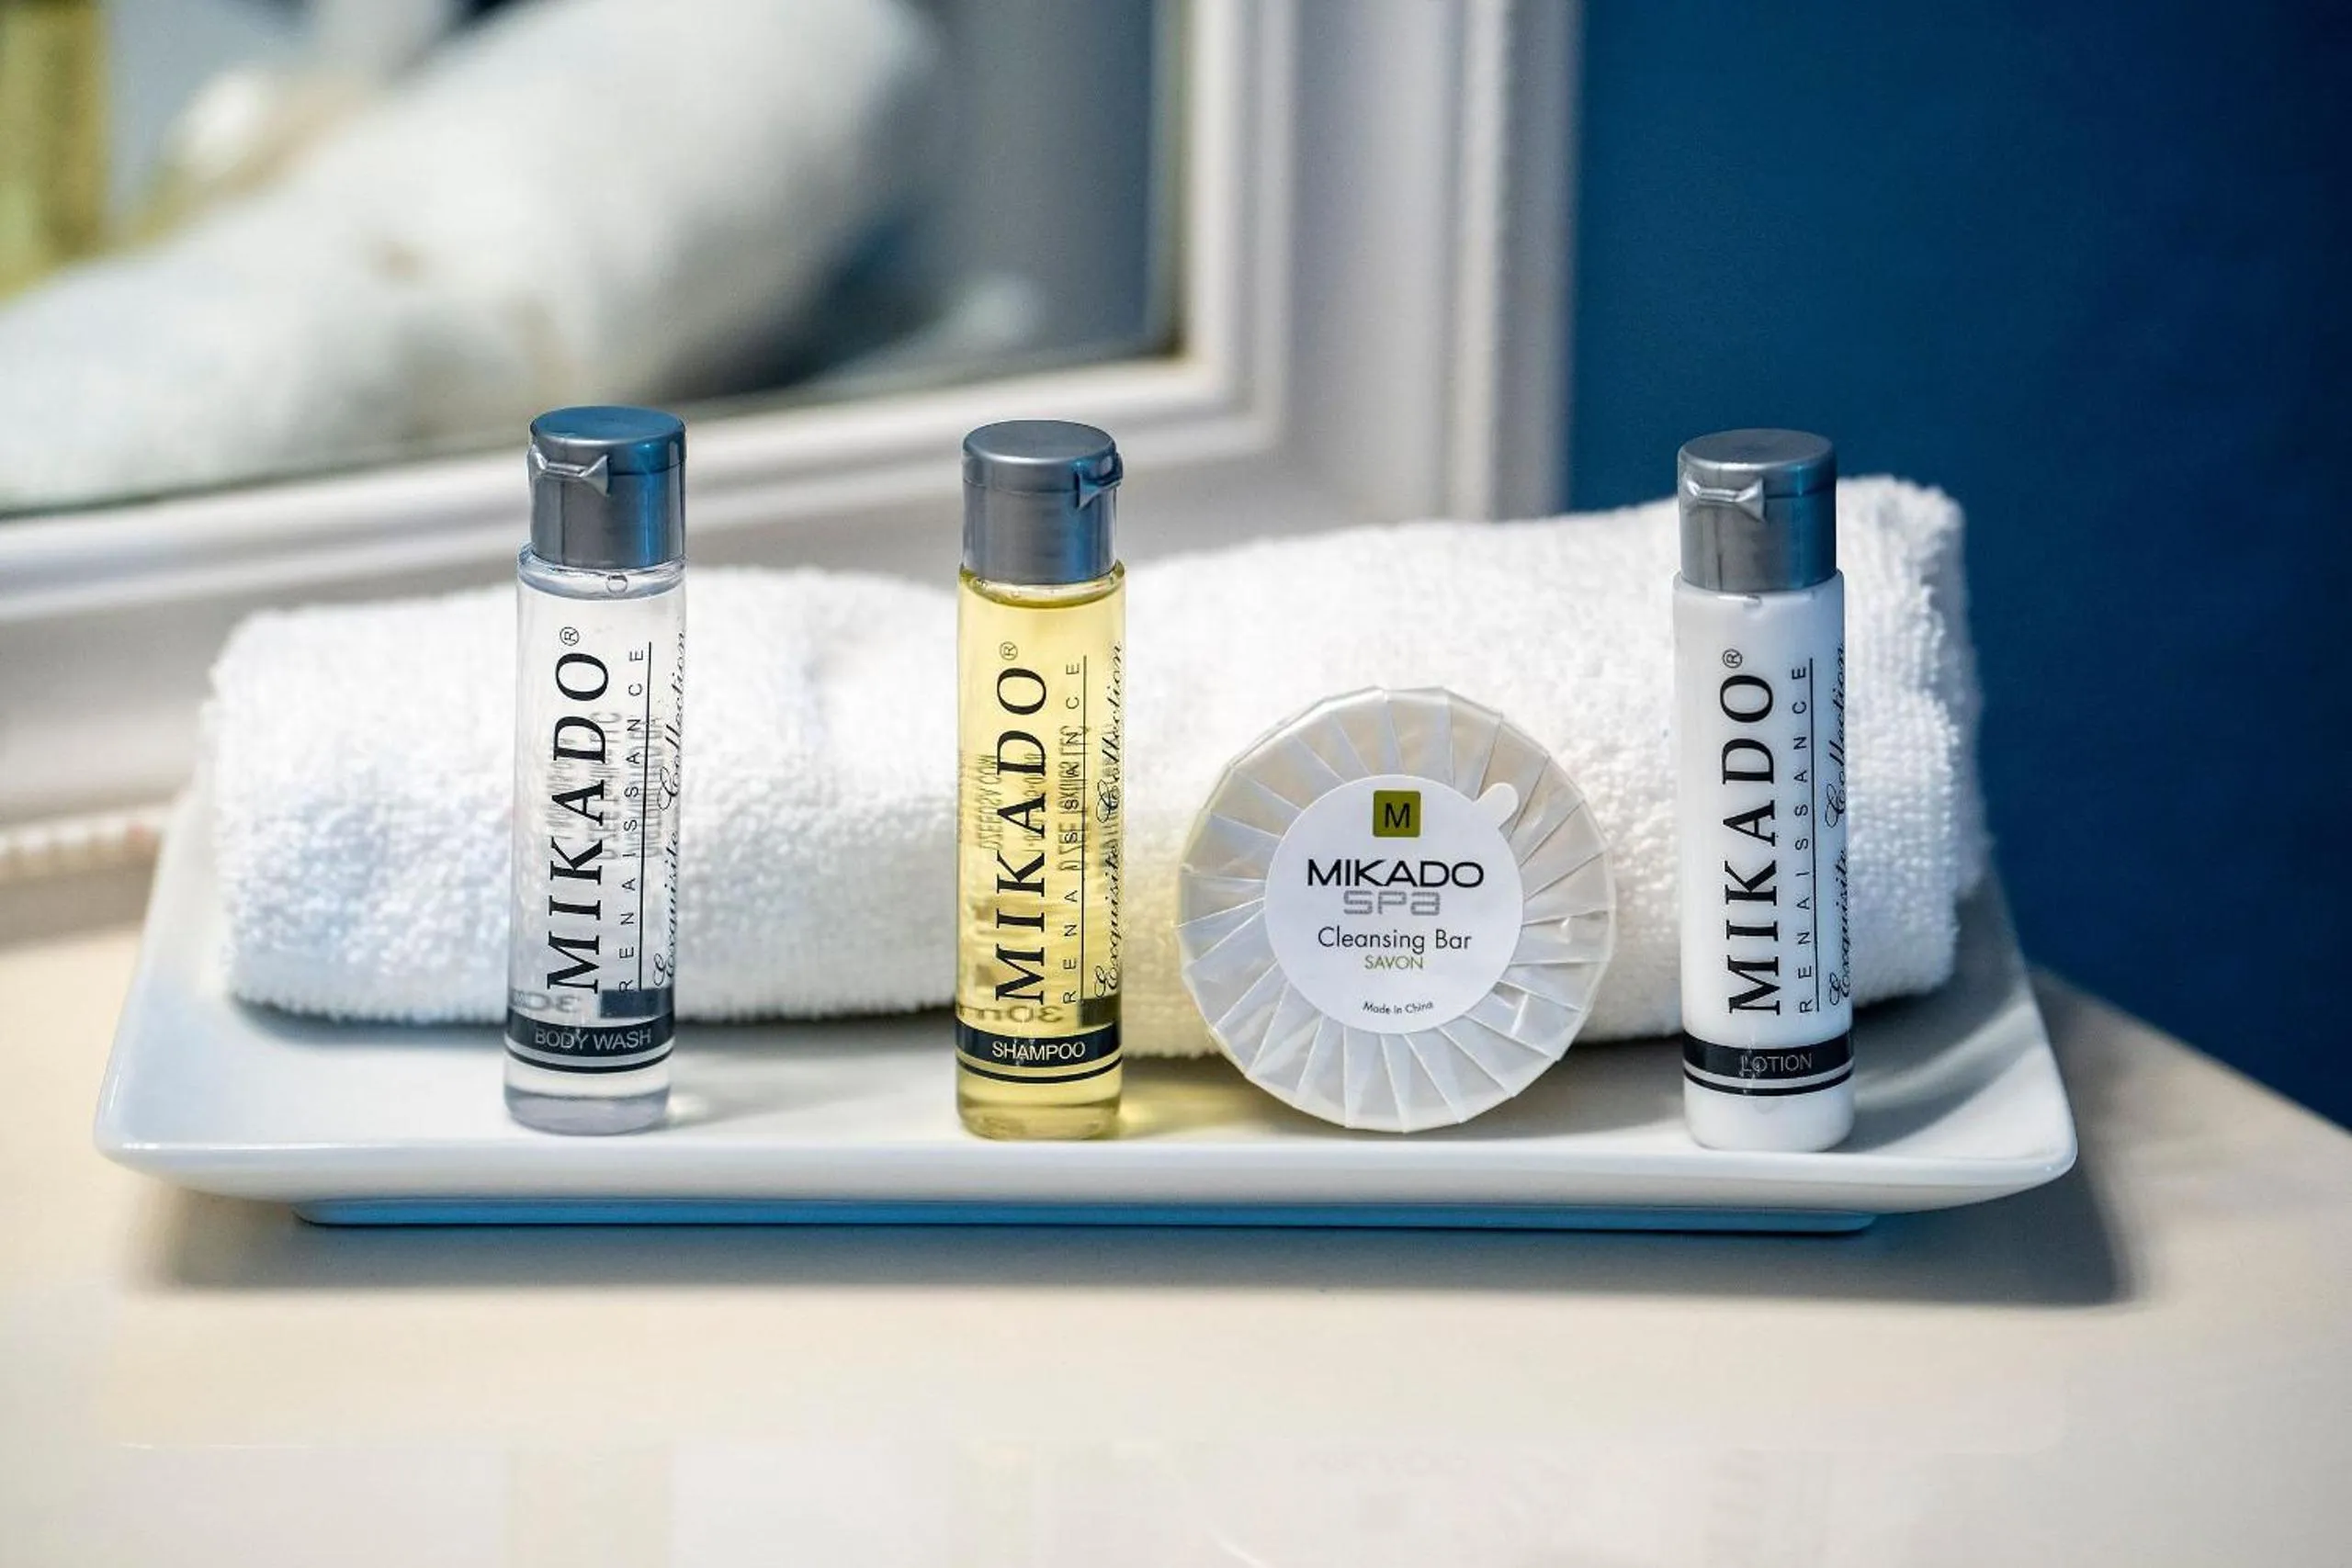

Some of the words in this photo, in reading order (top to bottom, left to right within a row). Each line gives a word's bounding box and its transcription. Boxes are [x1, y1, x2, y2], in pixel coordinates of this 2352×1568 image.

[617, 648, 643, 994] RENAISSANCE
[1384, 802, 1411, 829] M
[1062, 662, 1080, 1005] RENAISSANCE
[1792, 665, 1814, 1014] RENAISSANCE
[1307, 859, 1485, 888] MIKADO
[652, 829, 679, 988] Exquisite
[1317, 924, 1426, 955] Cleansing
[1434, 929, 1473, 951] Bar
[1364, 954, 1424, 970] SAVON
[1363, 1001, 1391, 1015] Made
[1405, 1000, 1434, 1014] China
[535, 1029, 588, 1051] BODY
[593, 1029, 652, 1051] WASH
[991, 1040, 1086, 1061] SHAMPOO
[1740, 1053, 1813, 1074] LOTION
